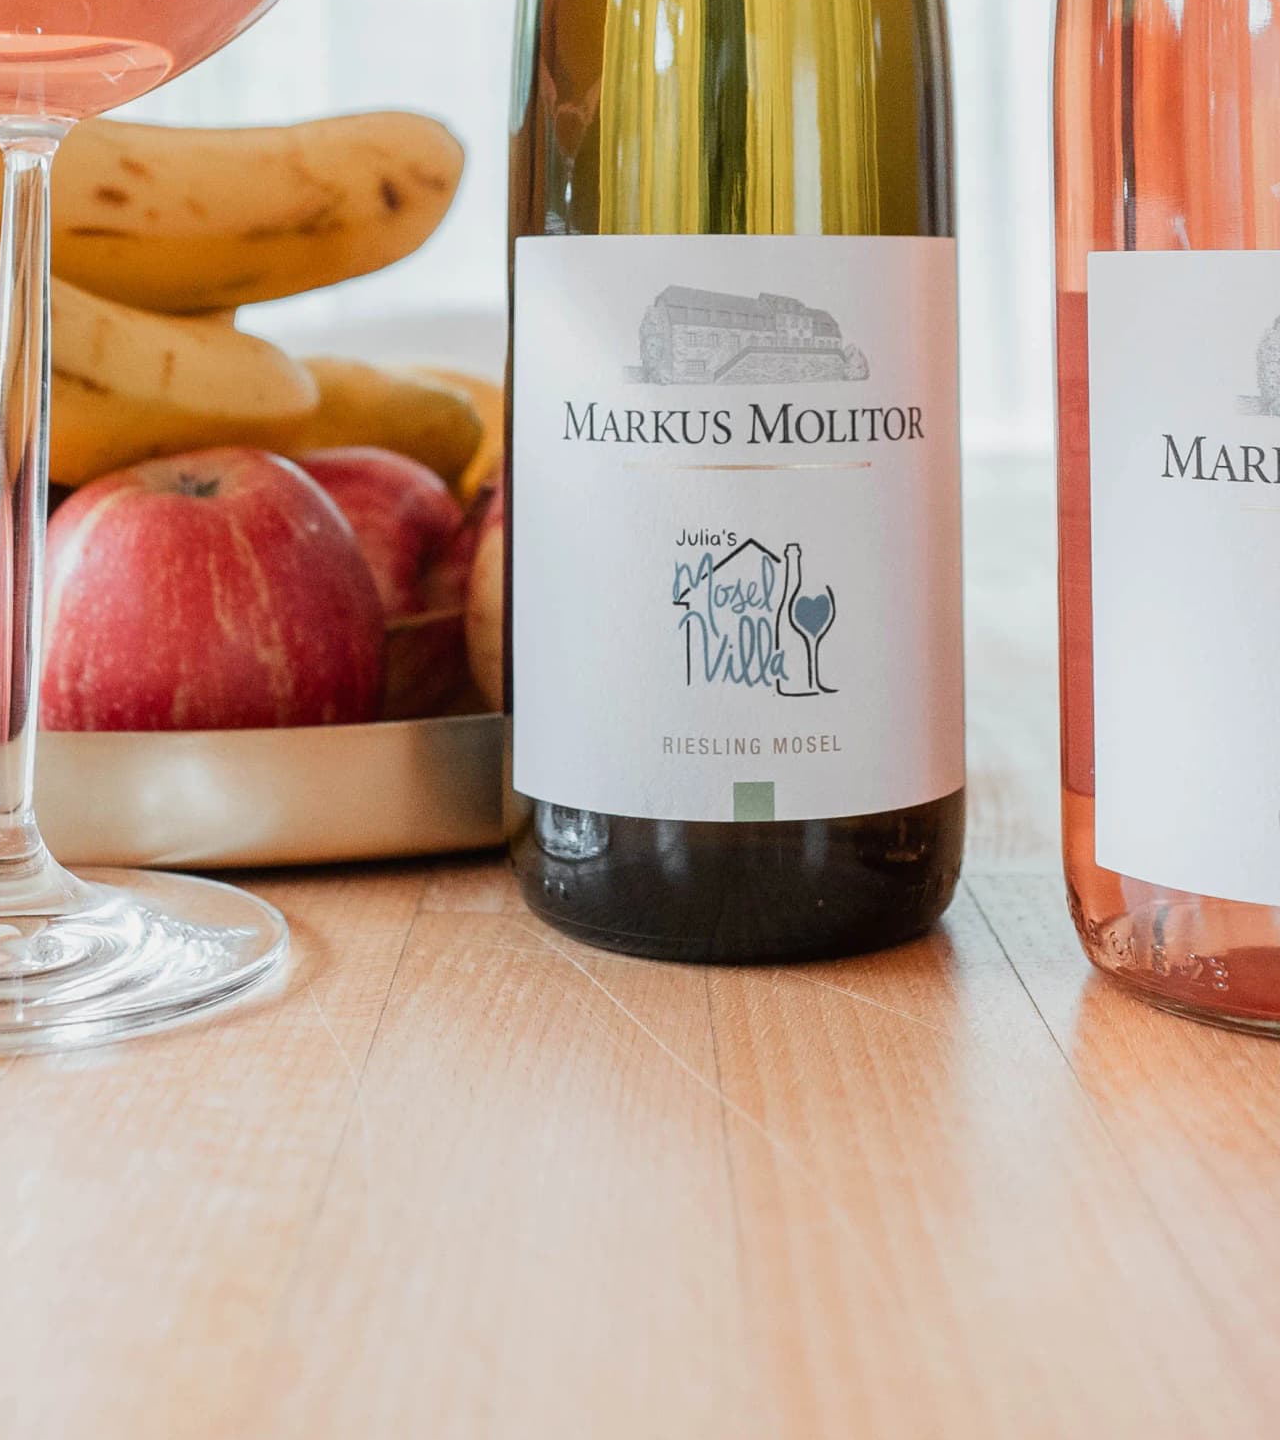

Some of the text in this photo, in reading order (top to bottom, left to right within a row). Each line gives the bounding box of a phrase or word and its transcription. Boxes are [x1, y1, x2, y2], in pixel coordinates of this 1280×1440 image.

[562, 400, 925, 445] MARKUS MOLITOR
[675, 528, 738, 547] Julia's
[672, 552, 776, 639] Mosel
[678, 610, 790, 688] Villa
[662, 734, 842, 756] RIESLING MOSEL
